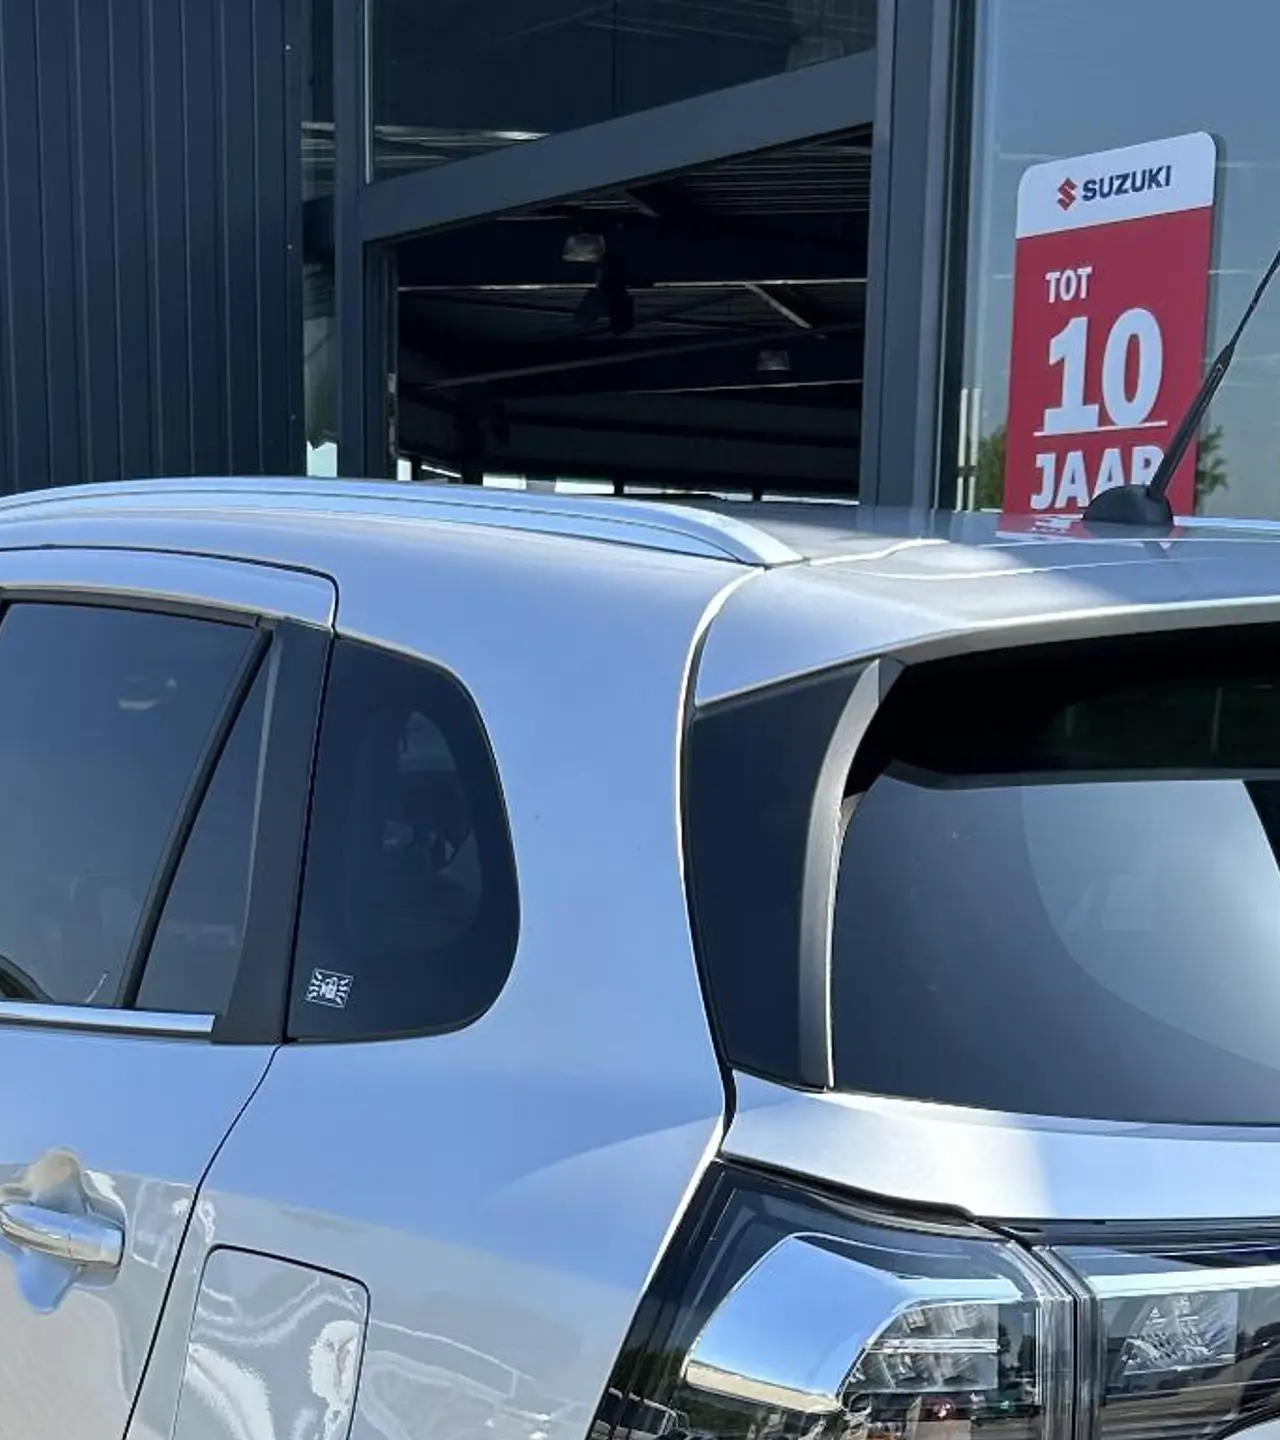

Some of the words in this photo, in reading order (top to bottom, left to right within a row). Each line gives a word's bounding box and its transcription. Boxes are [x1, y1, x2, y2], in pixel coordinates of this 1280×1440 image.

[1081, 164, 1172, 202] SUZUKI
[1045, 266, 1093, 303] TOT
[1043, 307, 1164, 435] 10
